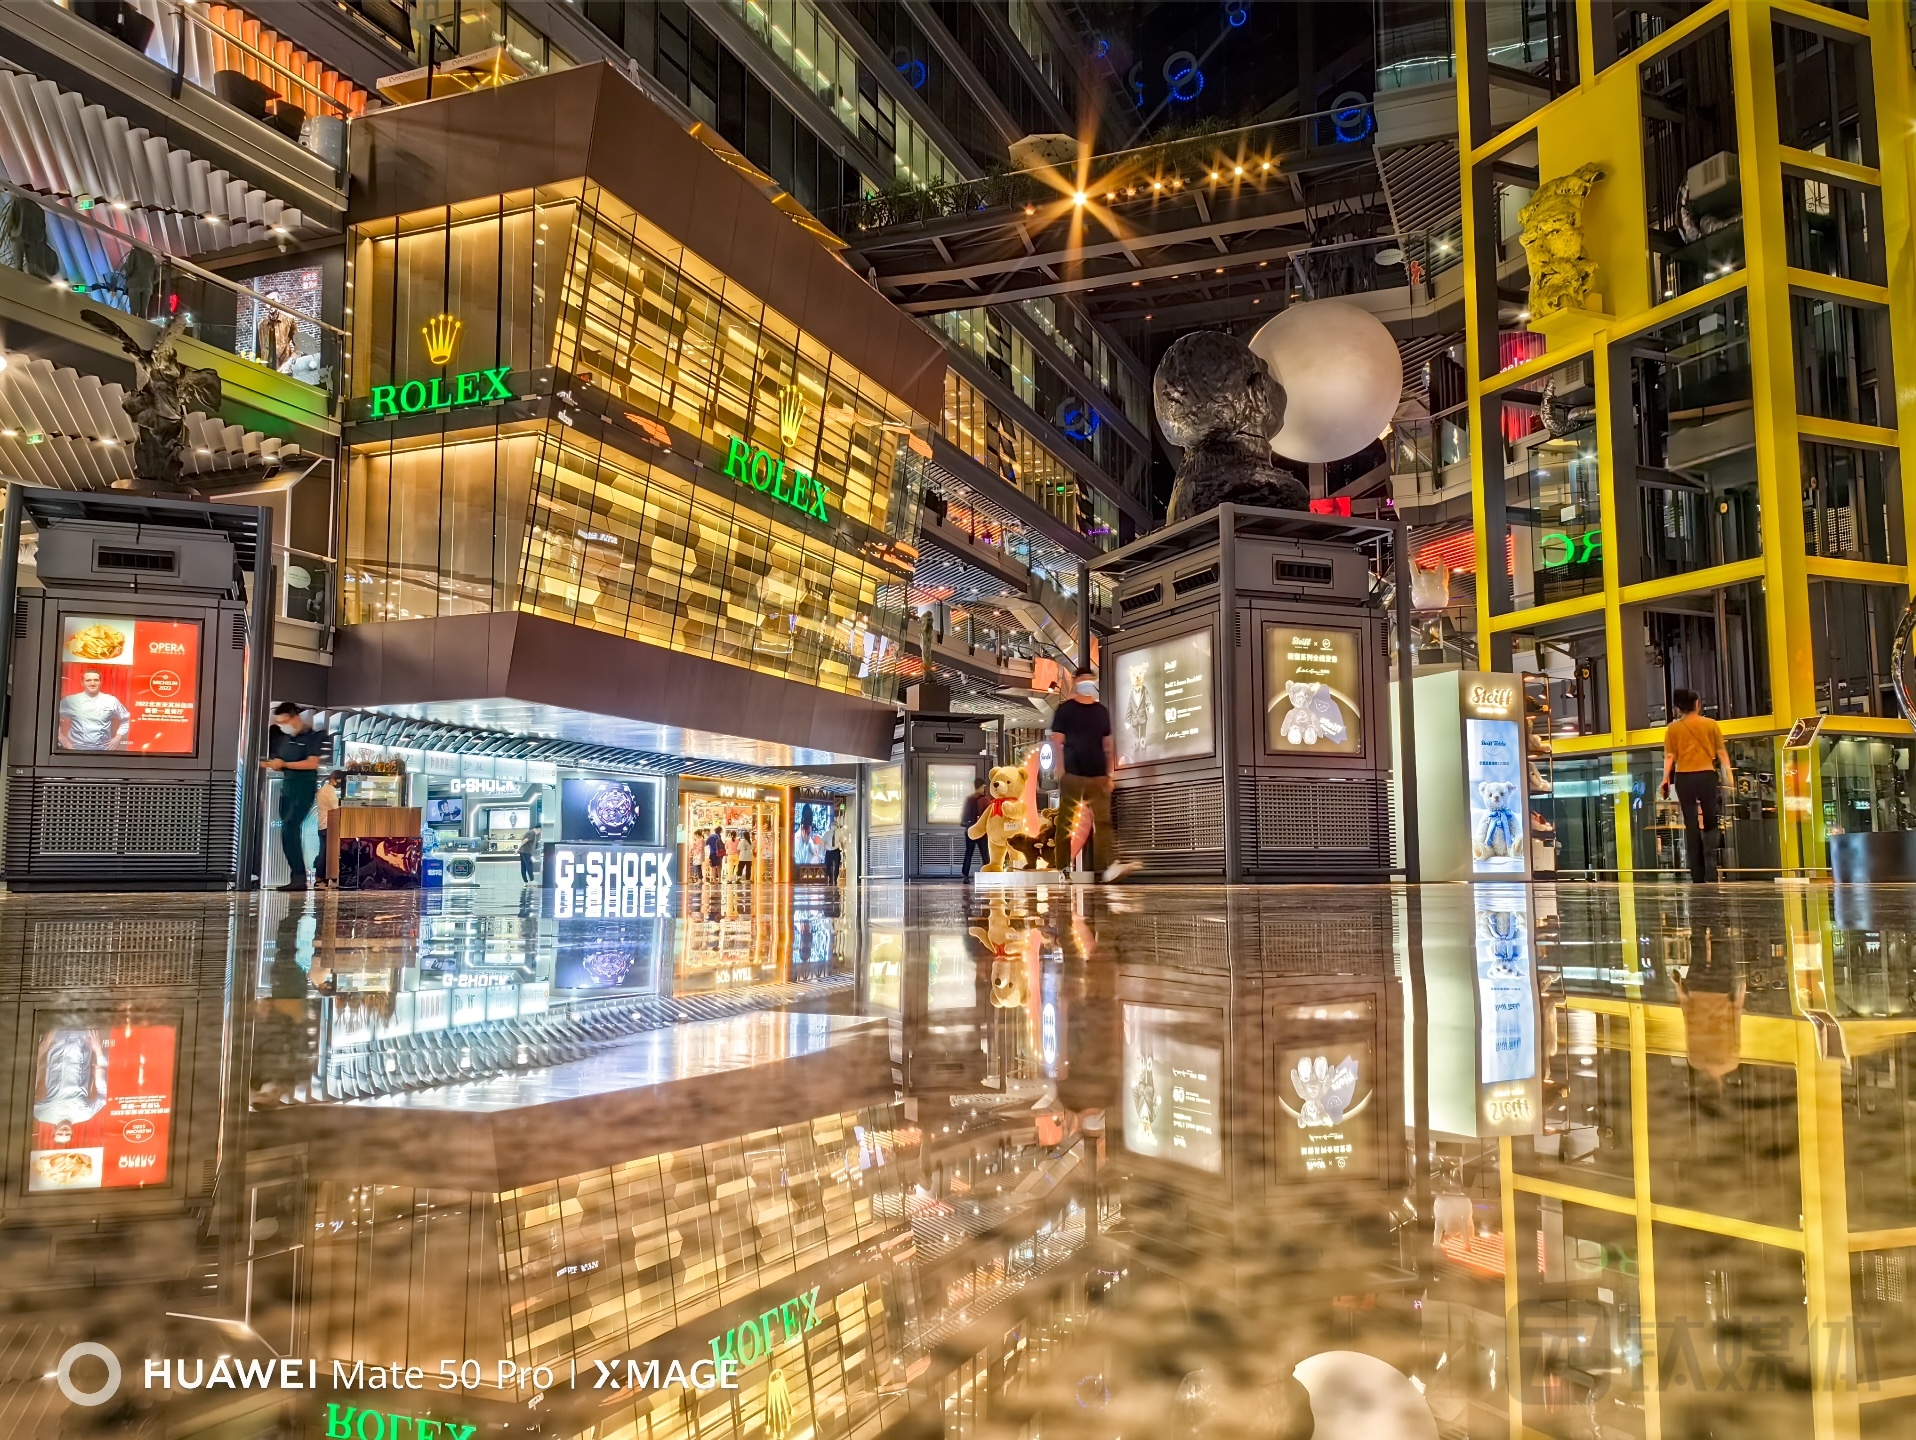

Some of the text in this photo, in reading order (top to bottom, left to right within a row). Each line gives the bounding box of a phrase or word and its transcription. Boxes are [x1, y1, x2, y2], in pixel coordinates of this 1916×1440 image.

[370, 367, 514, 418] ROLEX
[723, 435, 830, 523] ROLEX
[149, 642, 185, 652] OPERA
[1472, 686, 1513, 706] Steiff
[720, 785, 735, 797] POP
[736, 787, 757, 799] MART
[555, 850, 673, 886] G-SHOCK
